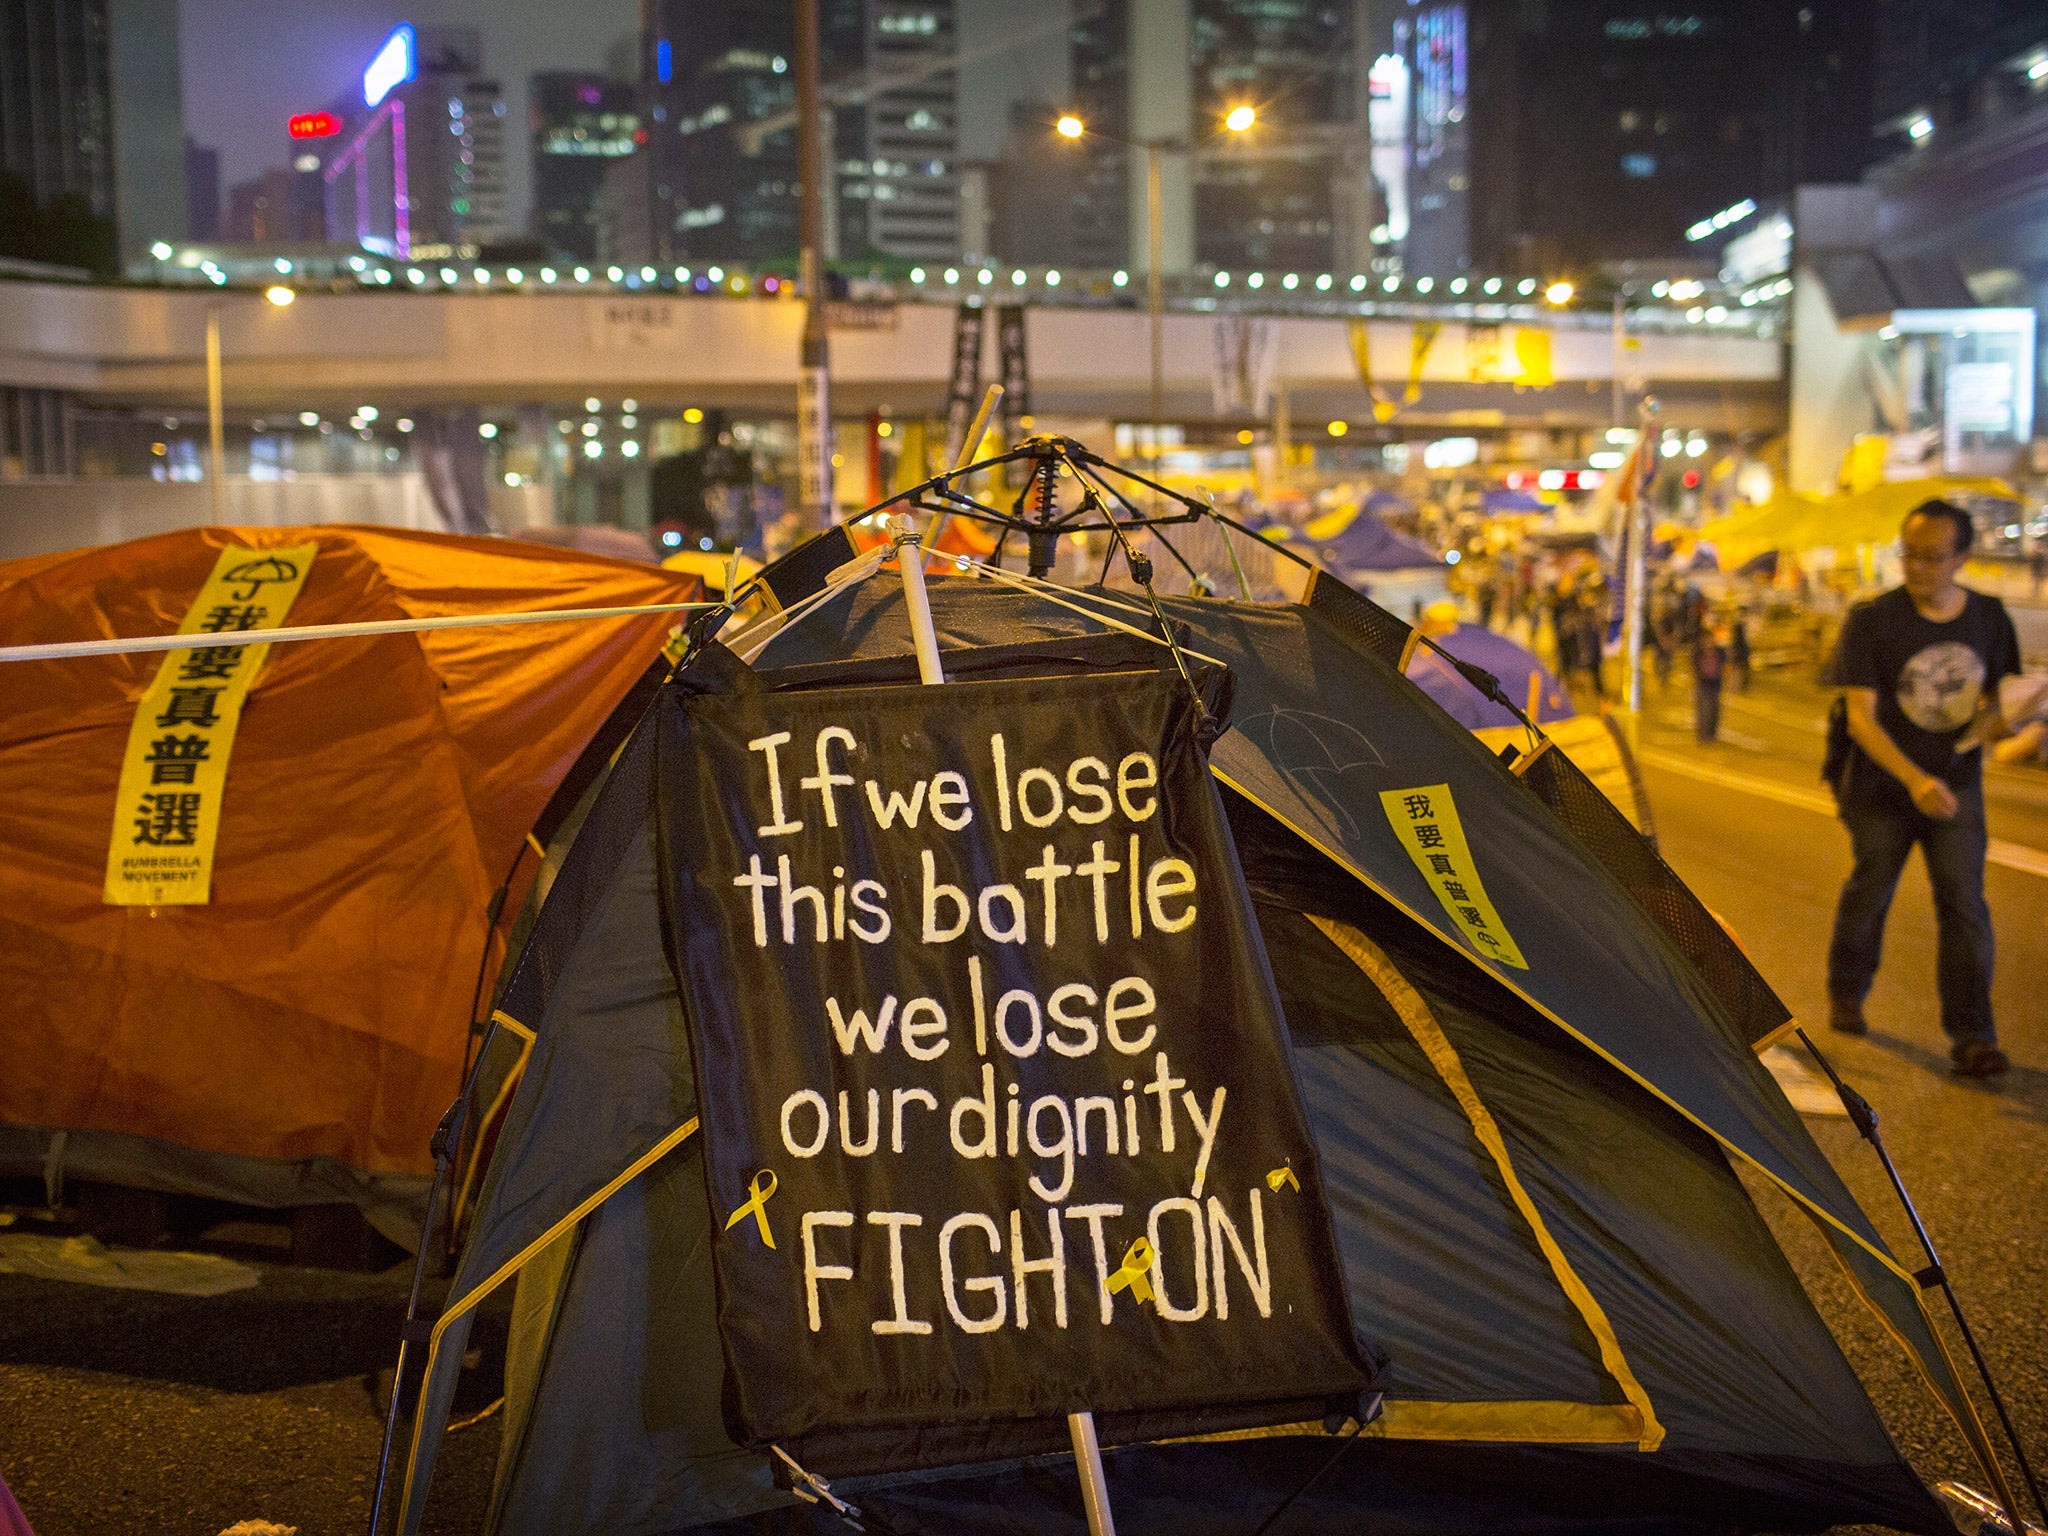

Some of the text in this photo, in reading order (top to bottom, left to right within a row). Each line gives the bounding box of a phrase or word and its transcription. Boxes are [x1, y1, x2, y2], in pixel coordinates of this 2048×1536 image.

[132, 604, 269, 846] 我要真普選
[748, 726, 1159, 837] If we lose
[121, 855, 201, 868] #UMBRELLA
[121, 870, 198, 883] MOVEMENT
[733, 833, 1197, 949] this battle
[1402, 793, 1488, 930] 我要真普選
[825, 955, 1158, 1062] we lose
[780, 1051, 1228, 1203] our dignity
[800, 1187, 1272, 1335] FIGHT ON
